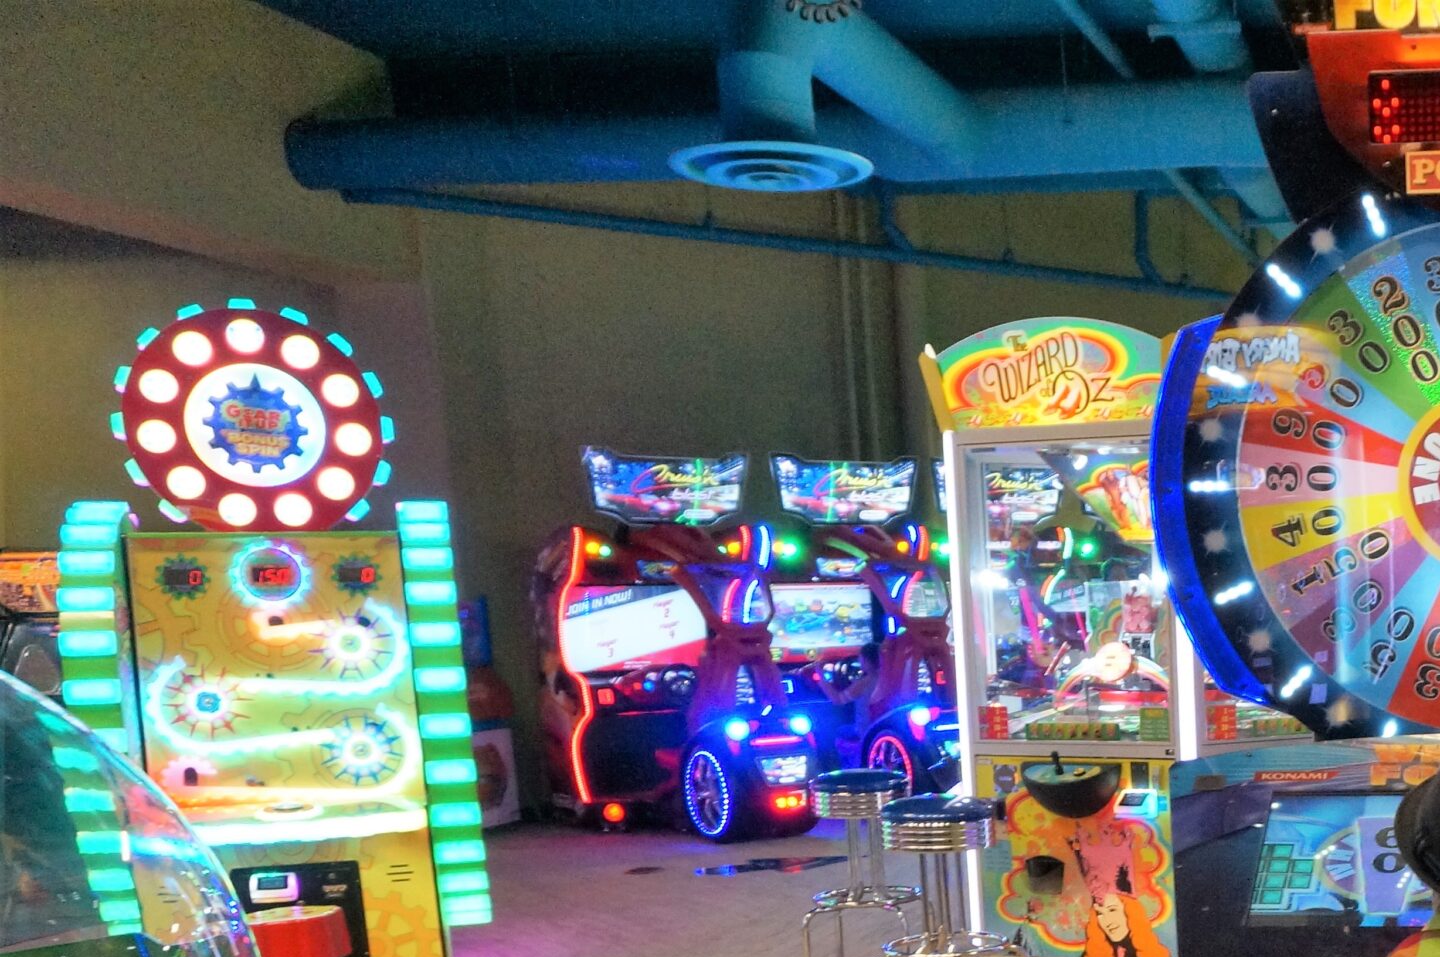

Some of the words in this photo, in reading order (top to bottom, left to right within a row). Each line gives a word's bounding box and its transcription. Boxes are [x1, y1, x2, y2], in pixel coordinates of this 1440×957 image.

[982, 331, 1079, 403] WIZARD
[1327, 309, 1390, 373] 30
[1265, 464, 1337, 492] 30
[1271, 506, 1344, 548] 40
[1290, 529, 1391, 596] 150
[565, 599, 589, 616] JOIN
[1363, 606, 1416, 680] 50
[1260, 770, 1328, 781] KONAMI
